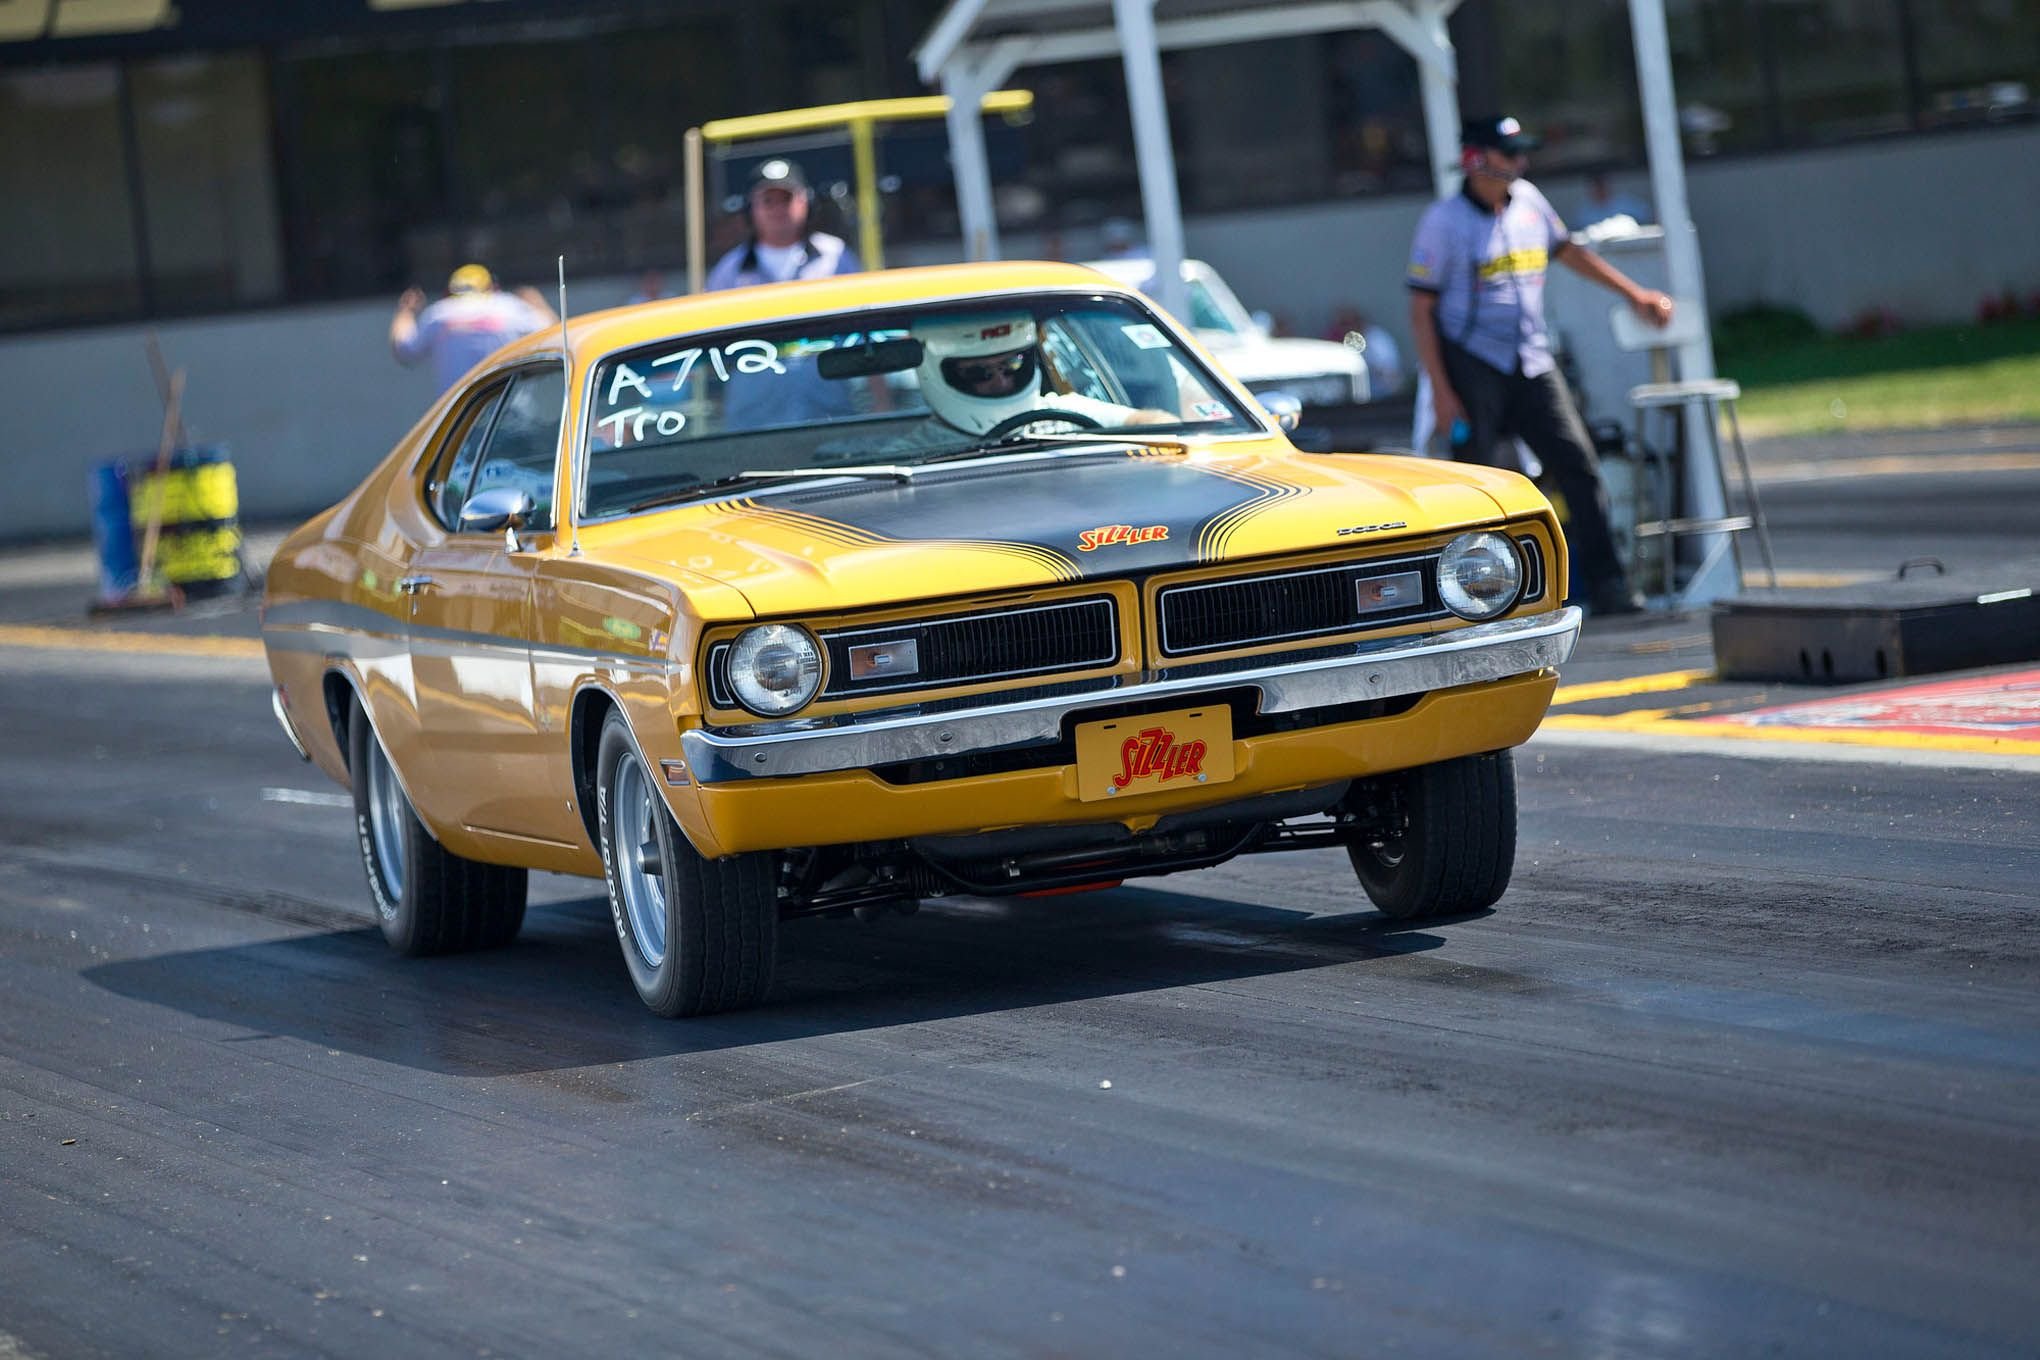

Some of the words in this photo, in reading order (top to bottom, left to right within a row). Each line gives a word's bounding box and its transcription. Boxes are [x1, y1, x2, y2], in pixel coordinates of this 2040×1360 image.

[1076, 523, 1170, 552] SIZZLER
[1337, 521, 1408, 536] DODGE
[1112, 726, 1208, 789] SIZZLER
